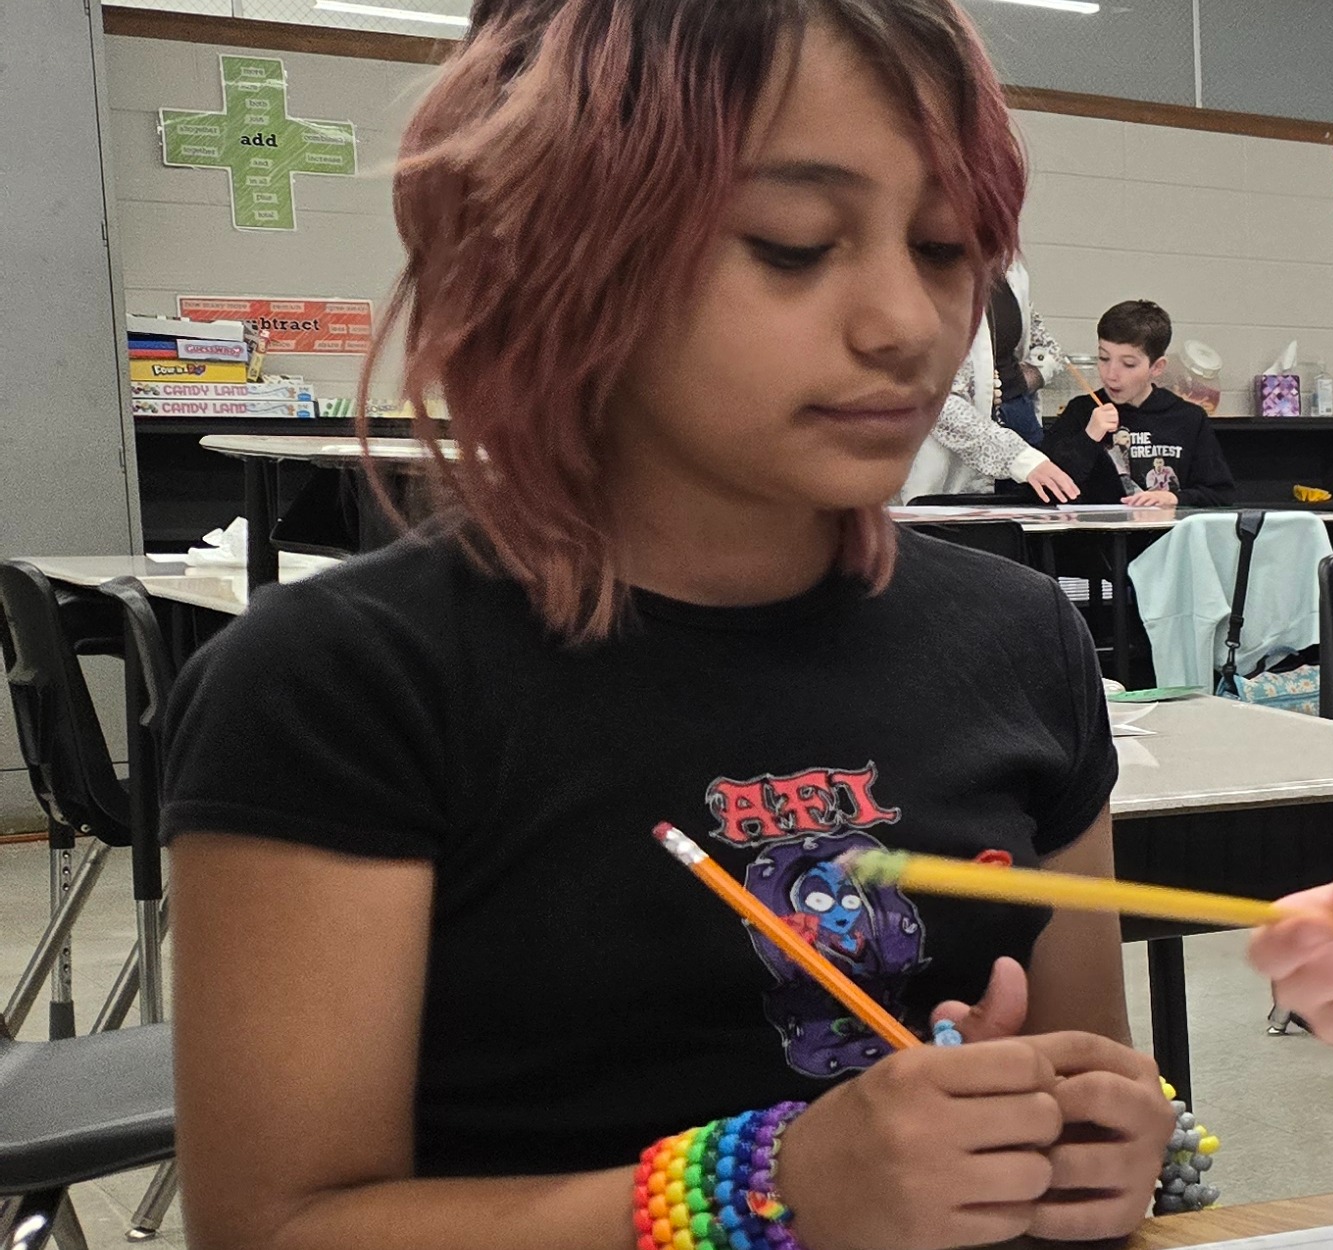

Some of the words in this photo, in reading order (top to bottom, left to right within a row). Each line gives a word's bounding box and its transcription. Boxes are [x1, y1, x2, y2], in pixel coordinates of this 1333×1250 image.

[240, 133, 278, 147] add
[252, 317, 320, 331] btract
[163, 384, 209, 396] CANDY
[213, 384, 248, 396] LAND
[162, 402, 208, 413] CANDY
[213, 402, 248, 413] LAND
[1130, 432, 1151, 444] THE
[1131, 446, 1182, 458] GREATEST
[708, 763, 900, 846] AFI
